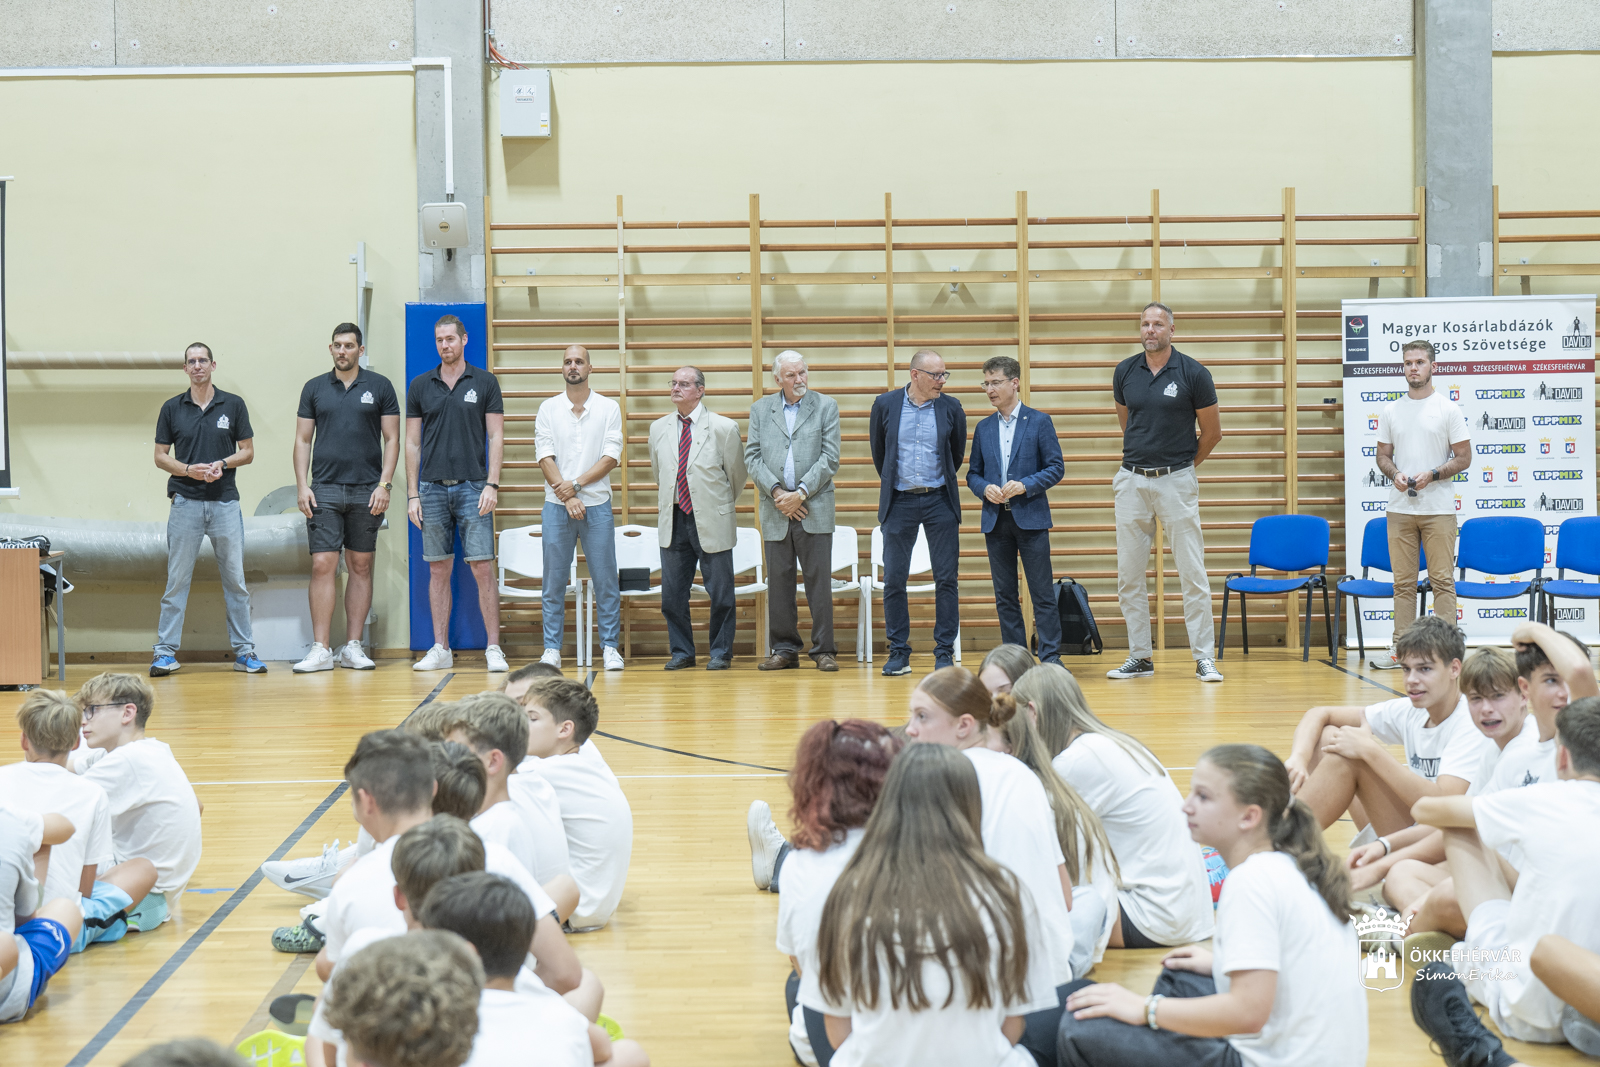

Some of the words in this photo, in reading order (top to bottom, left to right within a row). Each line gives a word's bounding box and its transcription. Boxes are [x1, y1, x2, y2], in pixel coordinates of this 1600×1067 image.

[1382, 322, 1437, 337] Magyar
[1443, 319, 1553, 333] Kosárlabdázók
[1463, 338, 1546, 352] Szövetsége
[1563, 336, 1587, 348] DAVID
[1472, 363, 1527, 372] SZÉKESFEHÉRVÁR
[1532, 362, 1586, 371] SZÉKESFEHÉRVÁR
[1555, 388, 1578, 399] DAVID
[1497, 418, 1521, 429] DAVID
[1555, 499, 1579, 510] DAVID
[1557, 608, 1580, 620] DAVID
